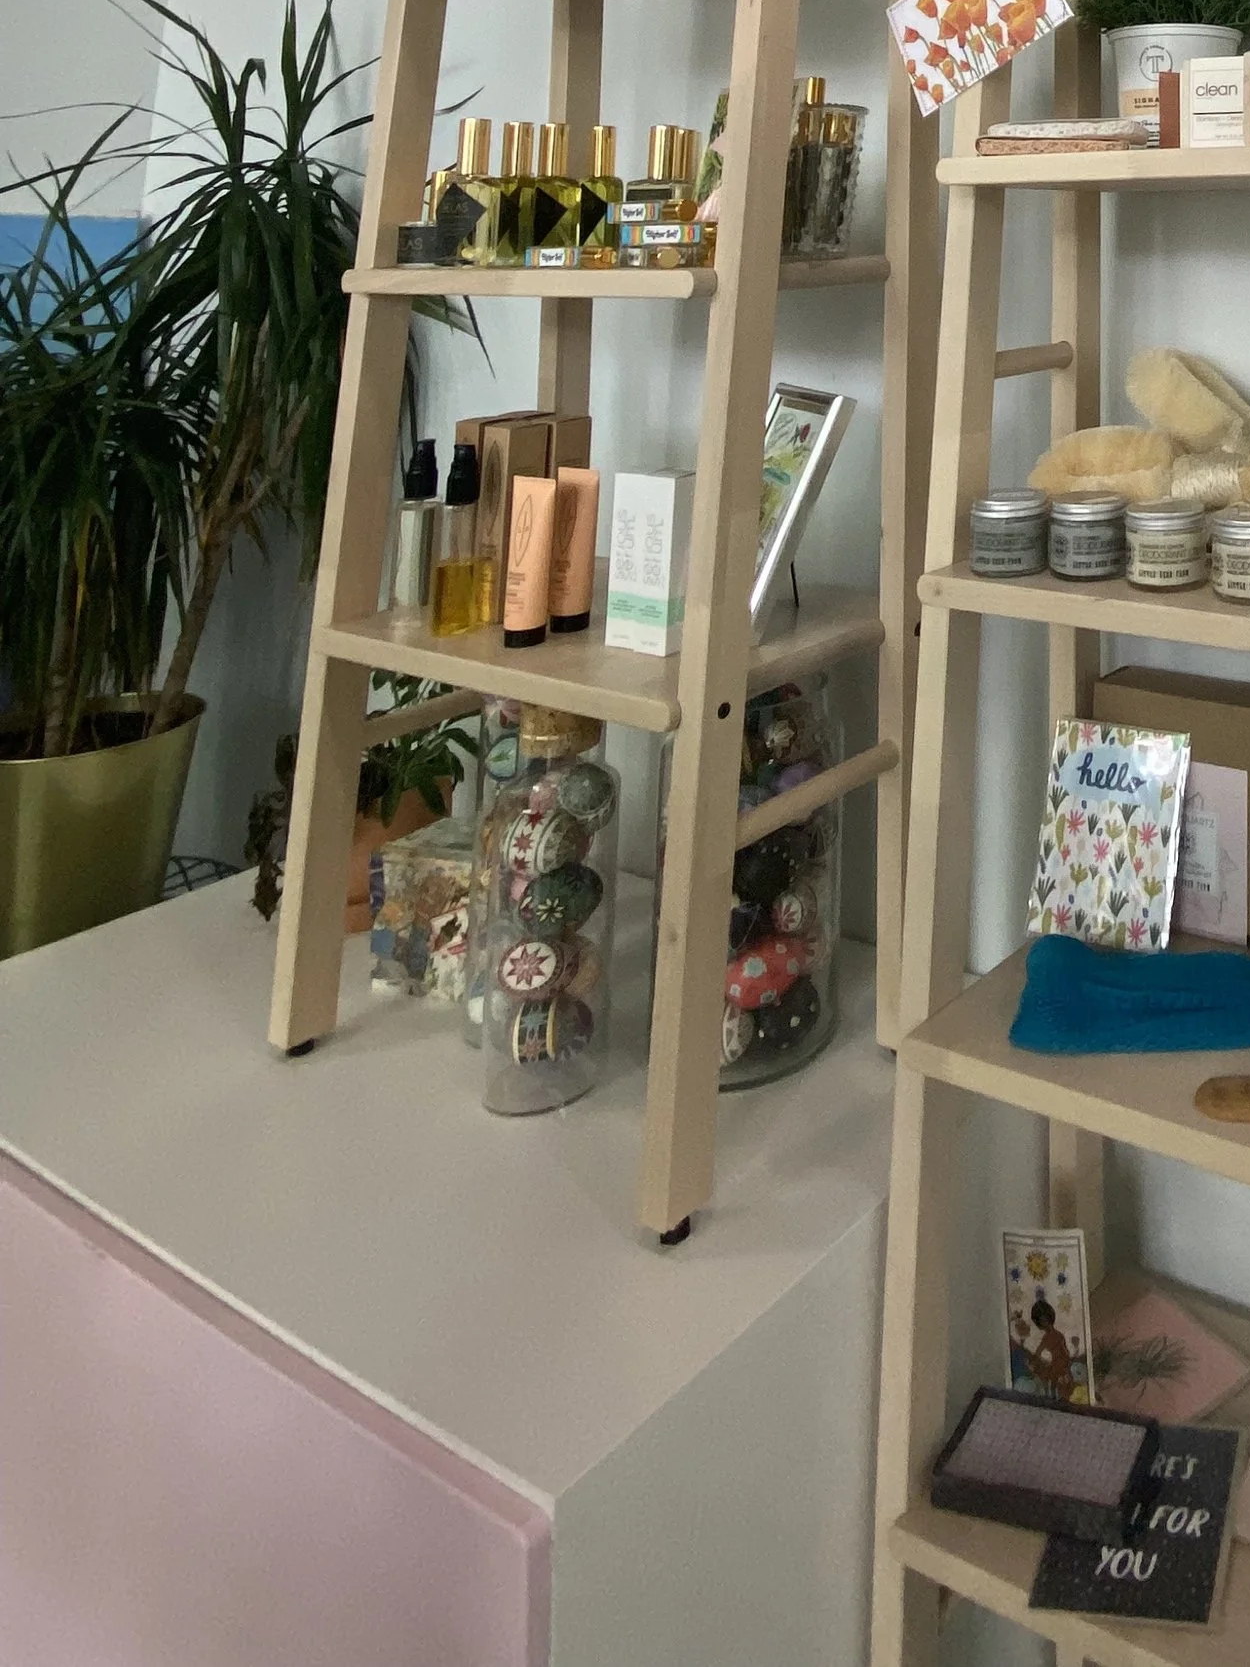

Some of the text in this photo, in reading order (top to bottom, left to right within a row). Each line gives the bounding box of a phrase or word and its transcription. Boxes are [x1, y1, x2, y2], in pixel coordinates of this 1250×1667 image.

[1195, 82, 1238, 97] clean
[1077, 752, 1146, 794] hello
[1150, 1504, 1211, 1538] FOR
[1094, 1545, 1158, 1582] YOU
